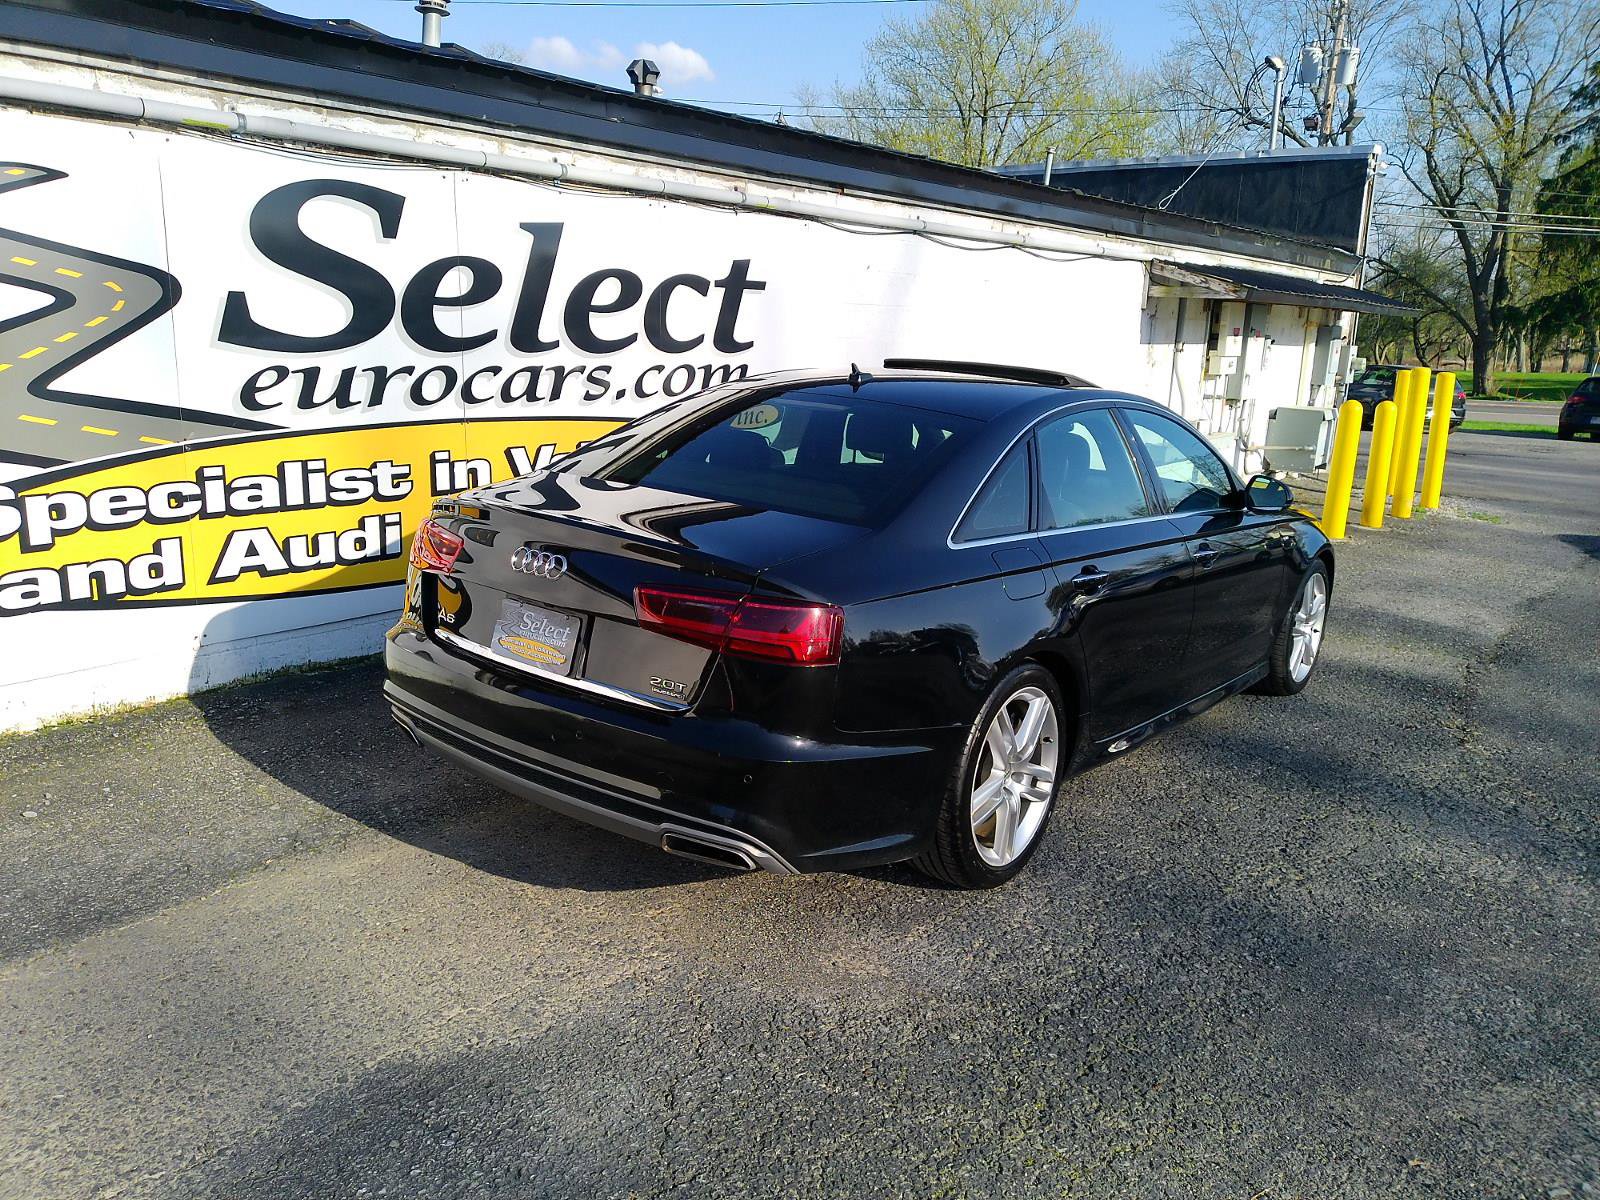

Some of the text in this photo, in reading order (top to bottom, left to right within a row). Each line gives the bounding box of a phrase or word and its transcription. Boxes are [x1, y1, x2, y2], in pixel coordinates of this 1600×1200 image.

[218, 178, 767, 354] Select
[239, 362, 749, 412] eurocars.com
[430, 450, 493, 497] in
[0, 512, 402, 616] and Audi
[520, 610, 572, 642] Select
